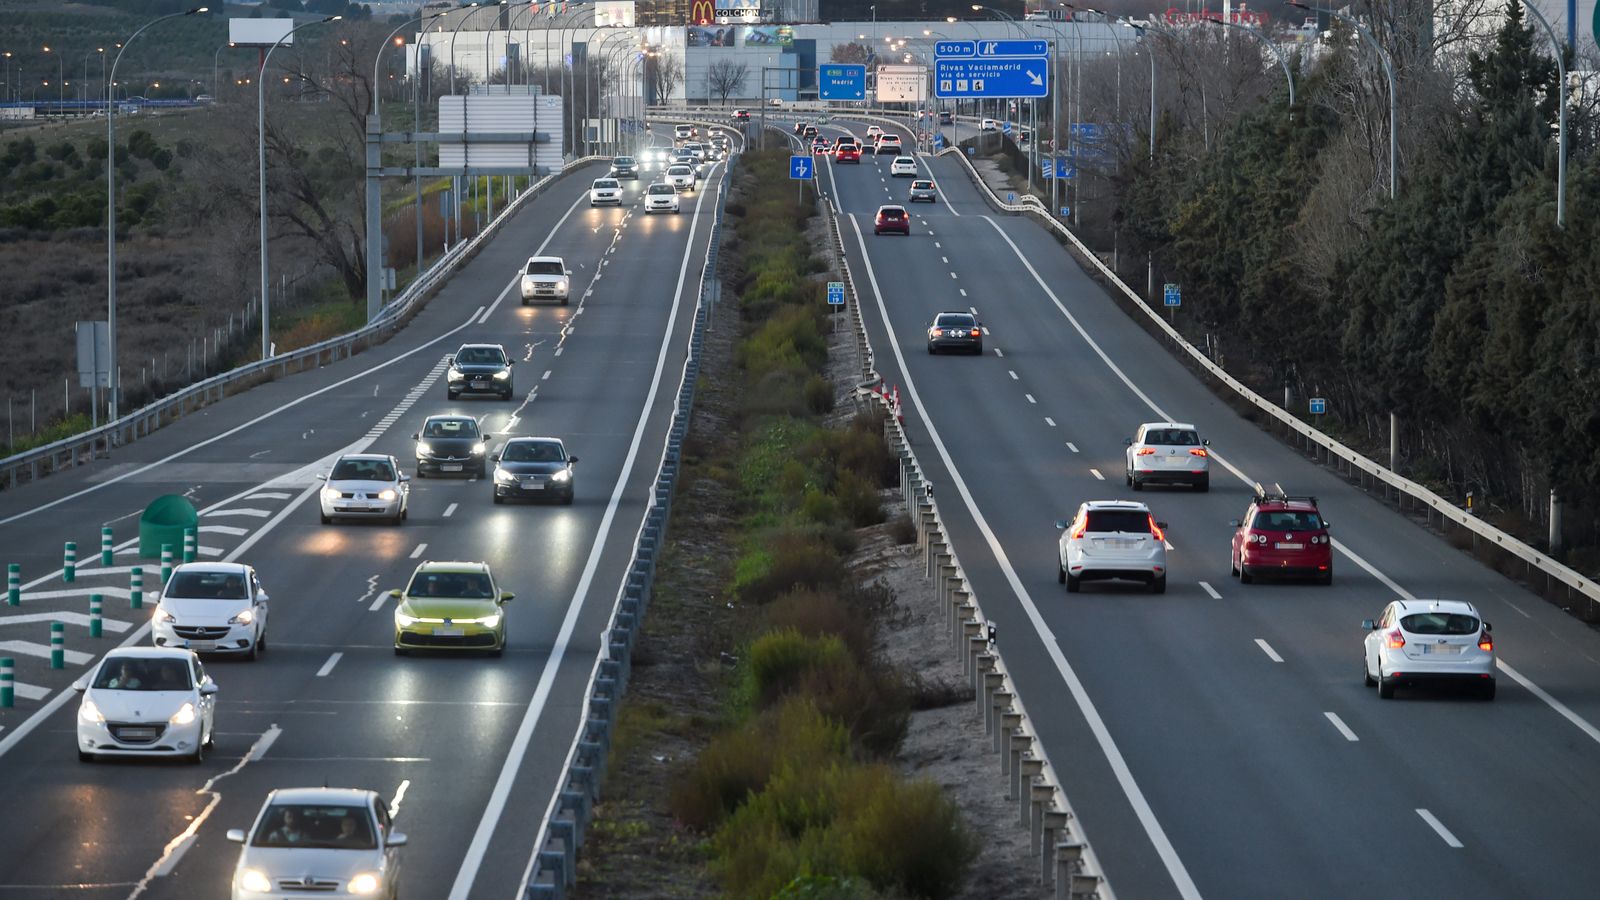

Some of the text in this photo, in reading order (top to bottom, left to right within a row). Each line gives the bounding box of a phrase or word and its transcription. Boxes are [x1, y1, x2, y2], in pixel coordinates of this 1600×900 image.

[716, 9, 759, 17] COLCHON
[940, 45, 961, 53] 500
[968, 63, 1021, 71] Vaciamadrid
